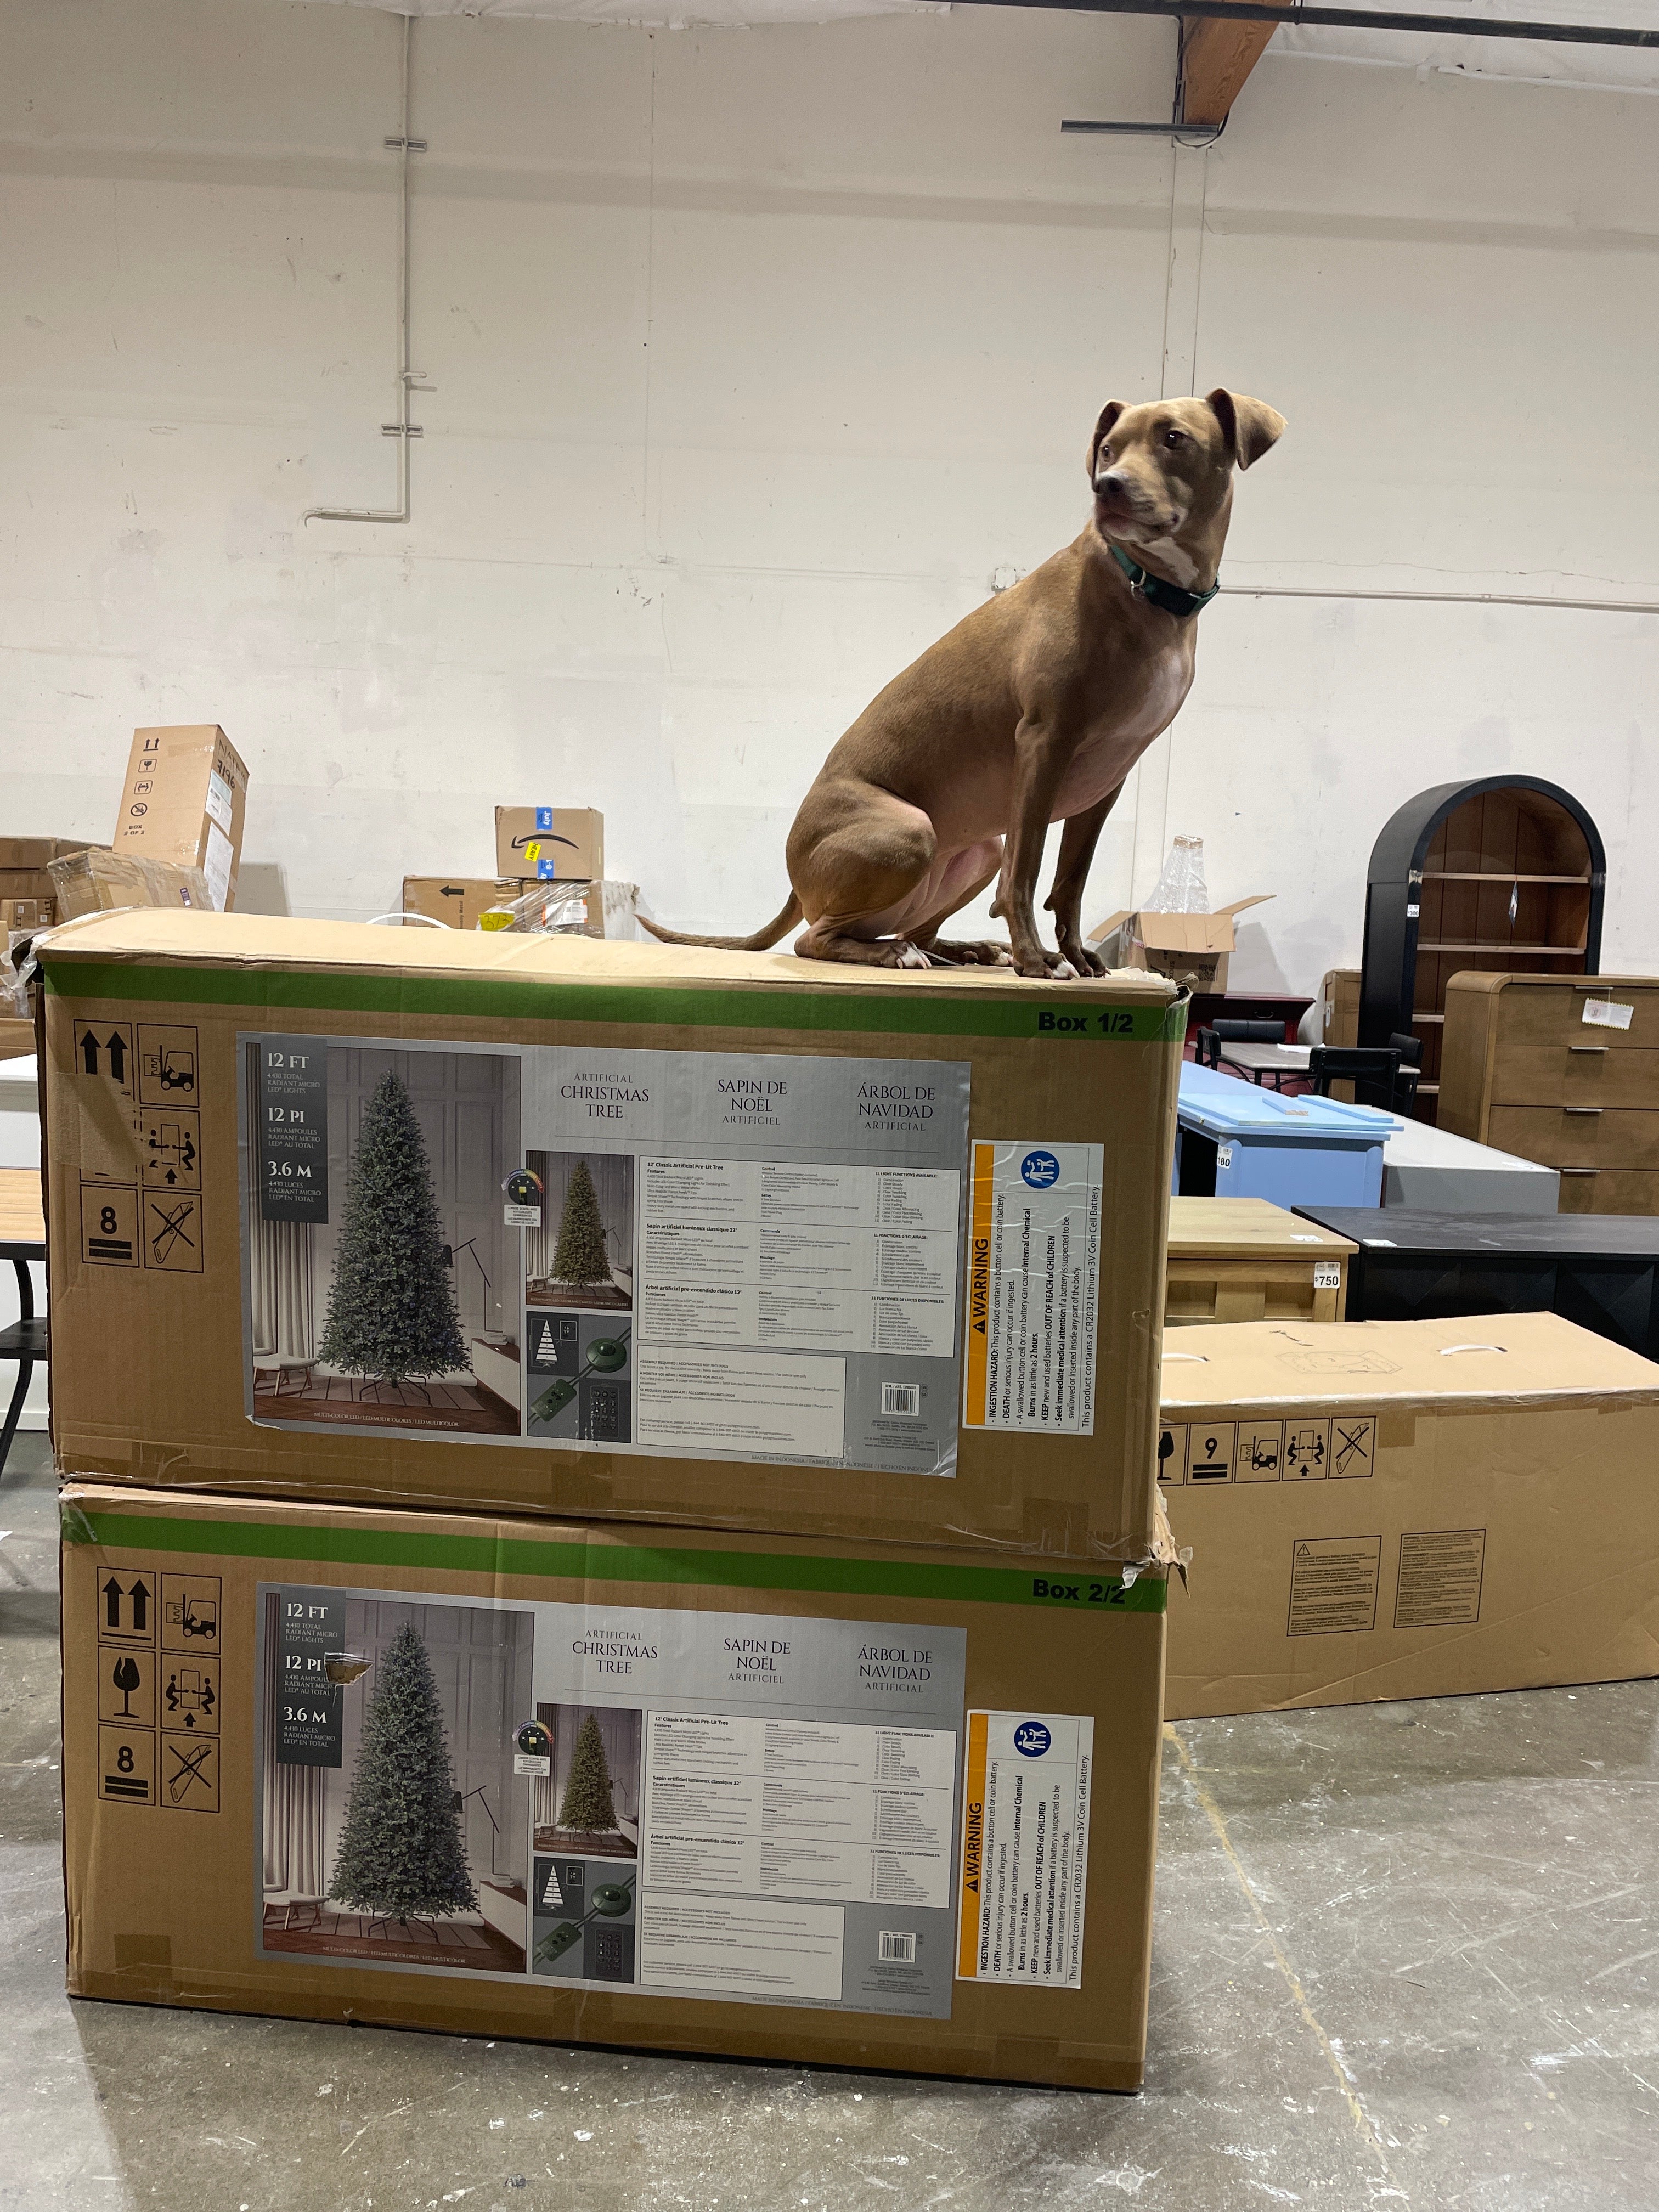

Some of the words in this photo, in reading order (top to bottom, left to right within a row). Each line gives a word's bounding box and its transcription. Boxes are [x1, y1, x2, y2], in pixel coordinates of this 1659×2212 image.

[543, 811, 551, 826] July
[529, 843, 538, 860] HEAVY
[1039, 1012, 1088, 1032] Box
[1097, 1013, 1133, 1033] 1/2
[268, 1053, 284, 1068] 12
[290, 1055, 309, 1069] FT
[574, 1073, 633, 1083] ARTIFICIAL
[718, 1079, 762, 1093] SAPIN
[768, 1081, 787, 1094] DE
[561, 1085, 649, 1102] CHRISTMAS
[857, 1082, 910, 1100] ÁRBOL
[915, 1087, 935, 1101] DE
[585, 1104, 623, 1118] TREE
[731, 1096, 773, 1112] NOËL
[859, 1103, 933, 1119] NAVIDAD
[268, 1107, 285, 1122] 12
[290, 1110, 304, 1123] PI
[723, 1115, 780, 1125] ARTIFICIEL
[865, 1121, 926, 1131] ARTIFICIAL
[268, 1161, 292, 1176] 3.6
[296, 1165, 312, 1177] M
[995, 1193, 1006, 1218] battery.
[1089, 1184, 1099, 1215] Battery.
[100, 1206, 117, 1234] 8
[1022, 1207, 1032, 1239] Chemical
[1088, 1217, 1097, 1233] Cell
[996, 1233, 1002, 1241] or
[1087, 1234, 1096, 1254] Coin
[994, 1242, 1002, 1253] cell
[1020, 1240, 1029, 1267] Internal
[993, 1253, 1002, 1276] button
[1087, 1254, 1096, 1266] 3V
[972, 1237, 989, 1317] WARNING
[1019, 1267, 1029, 1286] cause
[1086, 1267, 1095, 1299] Lithium
[1315, 1276, 1339, 1286] $750
[992, 1281, 1001, 1308] contains
[1019, 1299, 1029, 1323] battery
[1085, 1301, 1094, 1332] CR2032
[991, 1308, 1002, 1335] product
[1018, 1323, 1026, 1338] coin
[991, 1335, 999, 1348] This
[1017, 1346, 1026, 1357] cell
[1084, 1340, 1092, 1375] contains
[990, 1348, 998, 1380] HAZARD:
[1017, 1357, 1025, 1380] button
[989, 1380, 997, 1418] INGESTION
[1015, 1380, 1024, 1413] swallowed
[1082, 1376, 1093, 1409] product
[1081, 1410, 1090, 1427] This
[1205, 1437, 1218, 1459] 9
[1033, 1578, 1080, 1601] Box
[1088, 1583, 1125, 1604] 2/2
[287, 1603, 303, 1617] 12
[308, 1606, 328, 1619] FT
[585, 1630, 642, 1640] ARTIFICIAL
[572, 1641, 658, 1658] CHRISTMAS
[724, 1638, 767, 1653] SAPIN
[771, 1641, 791, 1654] DE
[857, 1644, 909, 1662] ÁRBOL
[914, 1650, 933, 1663] DE
[285, 1655, 302, 1669] 12
[307, 1658, 322, 1671] PI
[596, 1660, 633, 1674] TREE
[737, 1655, 777, 1671] NOËL
[728, 1673, 785, 1684] ARTIFICIEL
[859, 1664, 930, 1681] NAVIDAD
[865, 1682, 923, 1693] ARTIFICIAL
[284, 1706, 307, 1722] 3.6
[312, 1711, 326, 1723] M
[117, 1746, 134, 1773] 8
[1037, 1801, 1046, 1835] CHILDREN
[966, 1801, 982, 1877] WARNING
[1036, 1834, 1045, 1842] of
[997, 1842, 1008, 1869] ingested.
[1035, 1842, 1044, 1865] REACH
[1035, 1865, 1043, 1875] OF
[1034, 1875, 1042, 1890] OUT
[1020, 1891, 1029, 1911] hours.
[1032, 1890, 1042, 1916] batteries
[995, 1903, 1005, 1921] injury
[994, 1921, 1003, 1942] serious
[1019, 1923, 1027, 1938] little
[1032, 1916, 1041, 1931] used
[1031, 1931, 1040, 1944] and
[992, 1949, 1001, 1971] DEATH
[1017, 1951, 1025, 1970] Burns
[1030, 1957, 1039, 1974] KEEP
